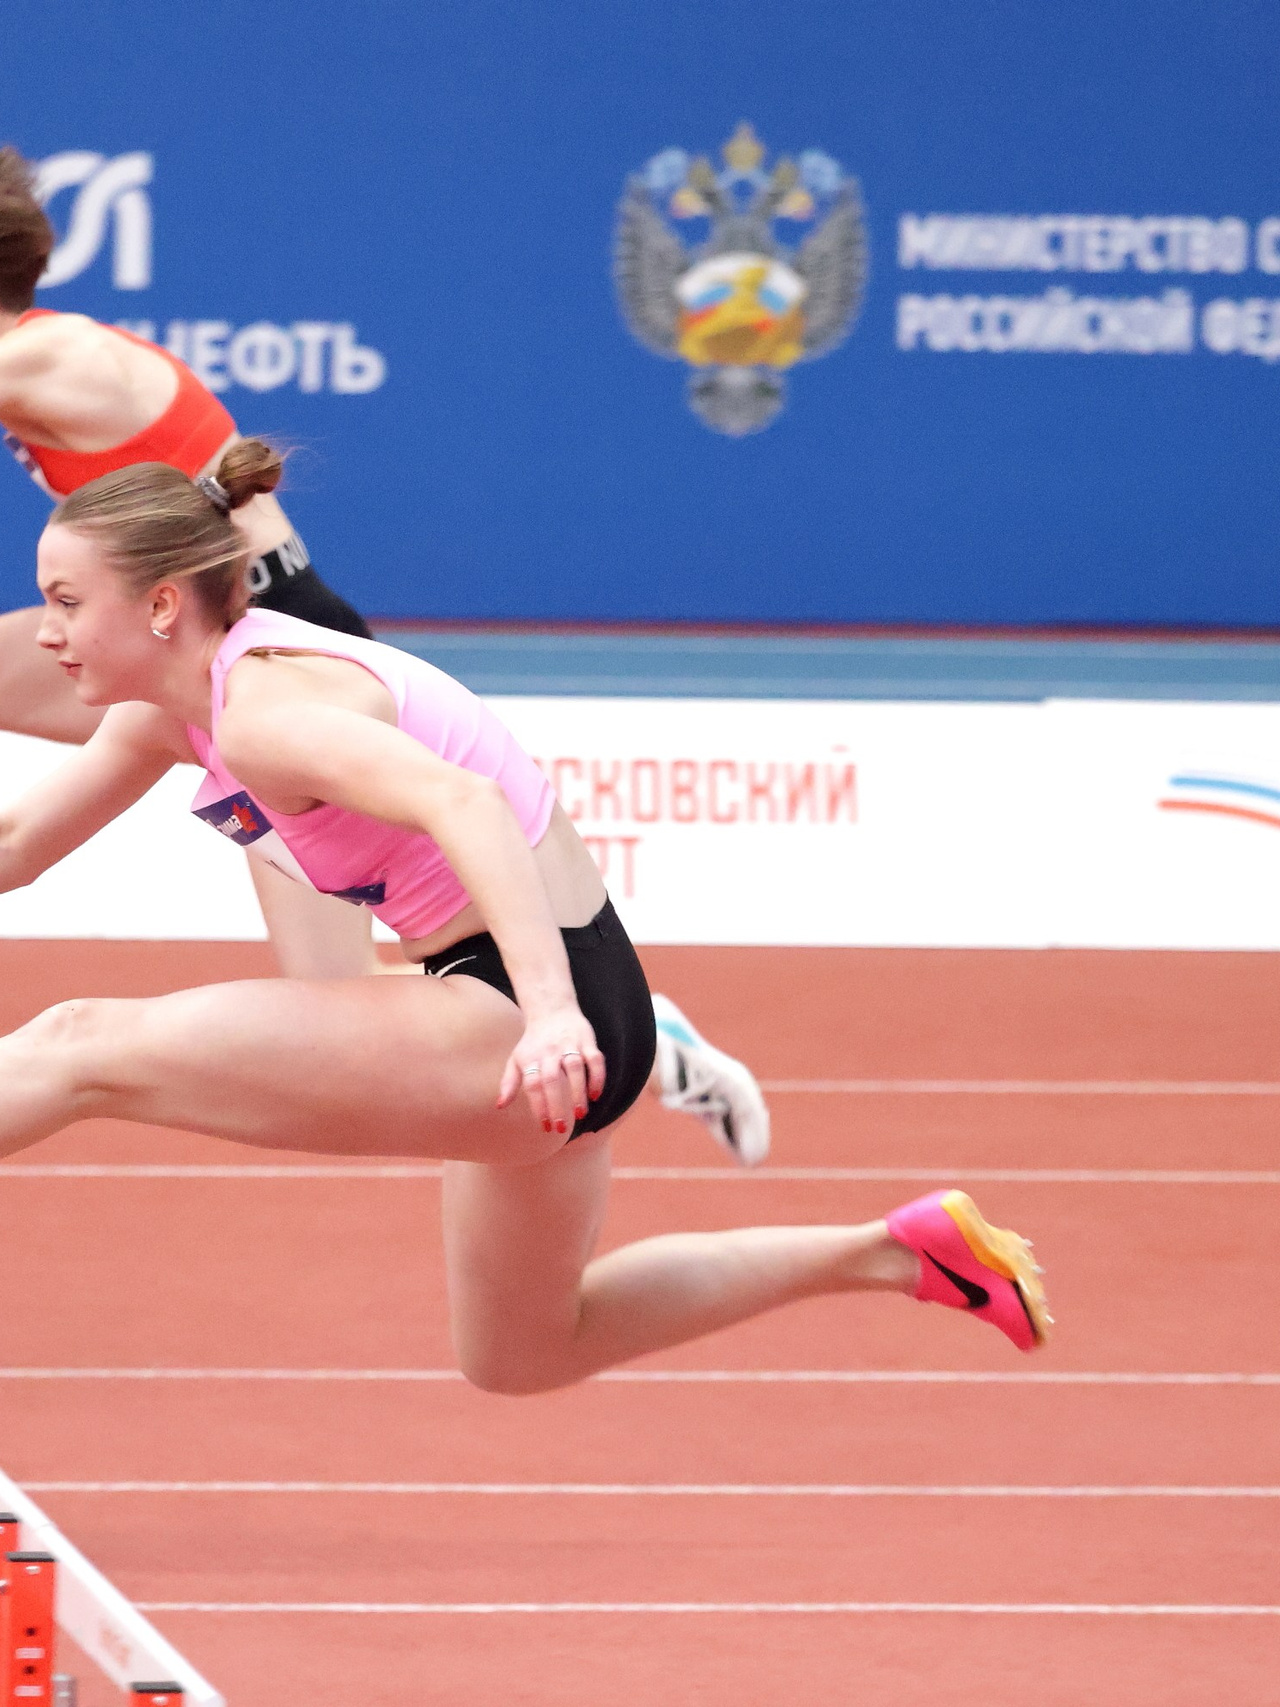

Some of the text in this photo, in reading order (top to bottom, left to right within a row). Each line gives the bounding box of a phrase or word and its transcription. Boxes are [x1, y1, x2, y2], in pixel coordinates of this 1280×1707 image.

[897, 213, 1249, 274] МИНИСТЕРСТВО
[897, 286, 1195, 354] РОССИЙСКОЙ
[533, 744, 859, 826] СКОВСКИЙ
